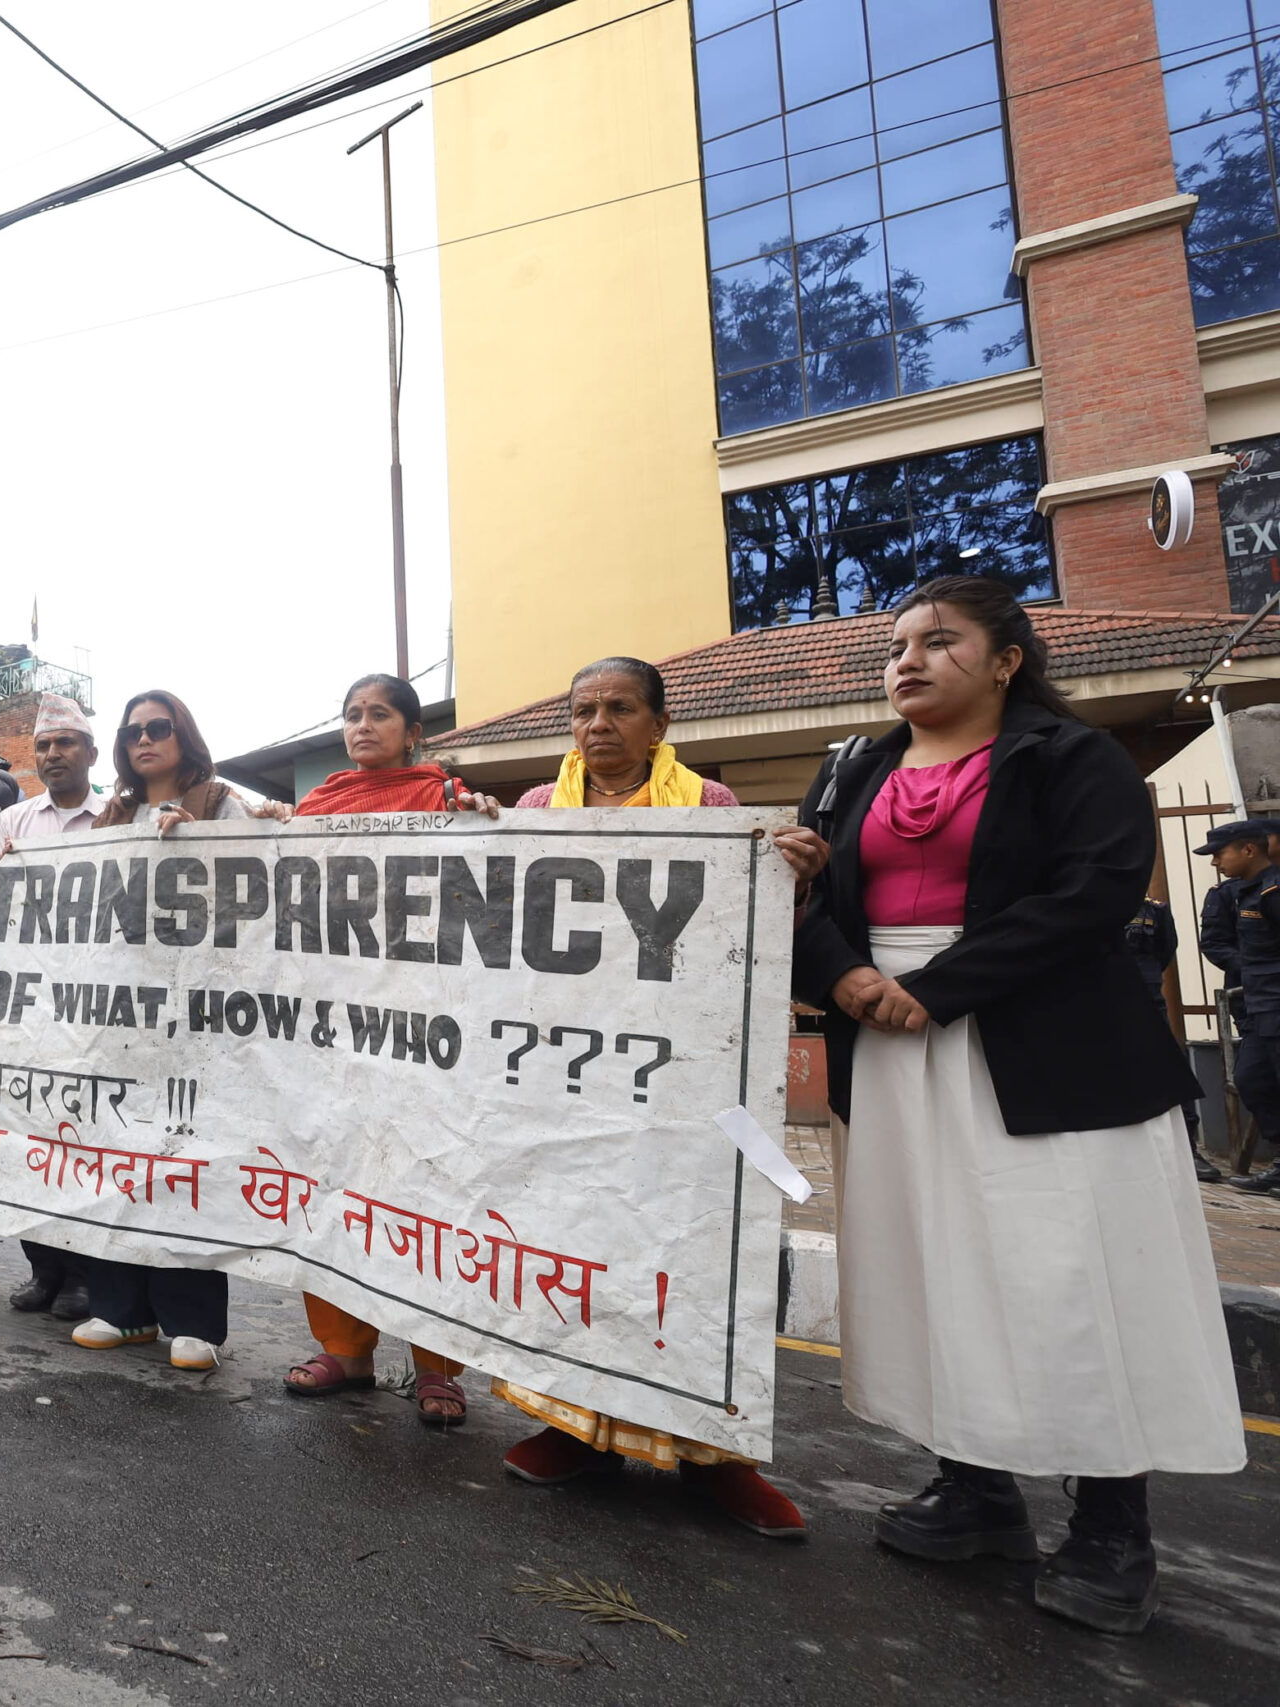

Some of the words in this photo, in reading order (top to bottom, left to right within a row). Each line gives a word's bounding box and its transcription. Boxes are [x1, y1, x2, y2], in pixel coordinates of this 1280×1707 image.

[1225, 519, 1280, 557] EX
[314, 814, 455, 832] TRANSPARENCY
[51, 982, 177, 1039] WHAT,
[188, 989, 302, 1041] HOW
[311, 1000, 337, 1048] &
[346, 1003, 462, 1070] WHO
[26, 1121, 210, 1212] बलिदान
[239, 1146, 319, 1234] खेर
